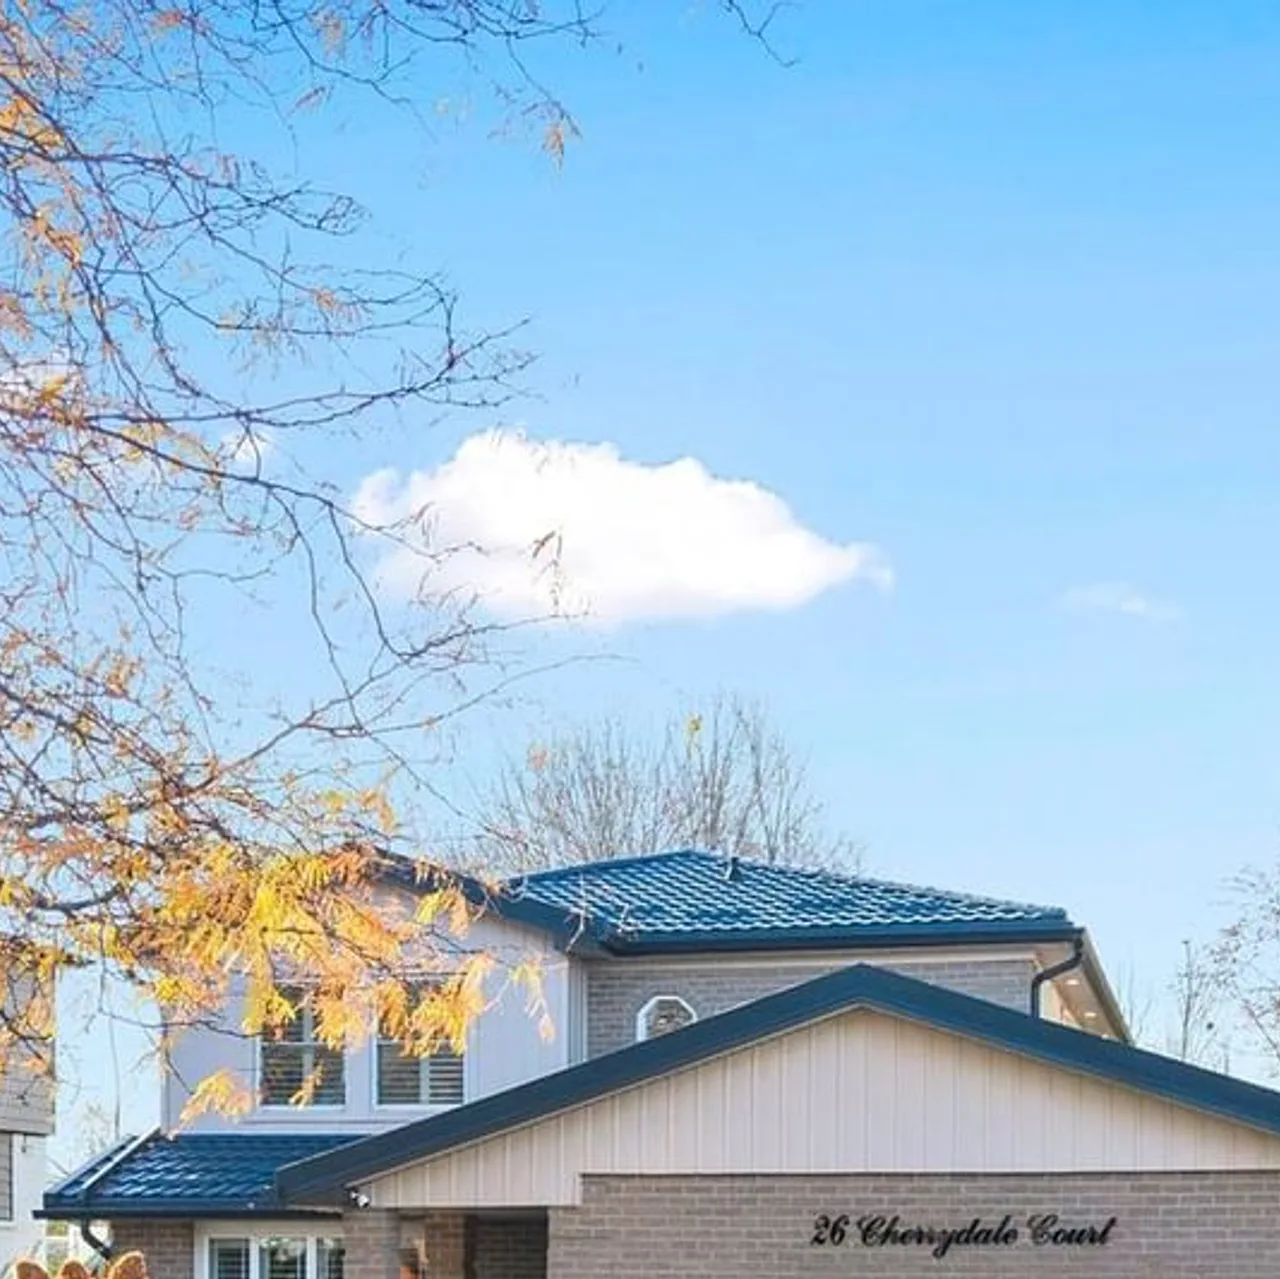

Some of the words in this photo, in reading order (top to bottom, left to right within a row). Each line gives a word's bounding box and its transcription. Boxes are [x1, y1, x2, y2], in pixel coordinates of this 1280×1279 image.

[810, 1214, 850, 1246] 26
[856, 1213, 1019, 1259] Cherrydale
[1026, 1213, 1118, 1246] Court
